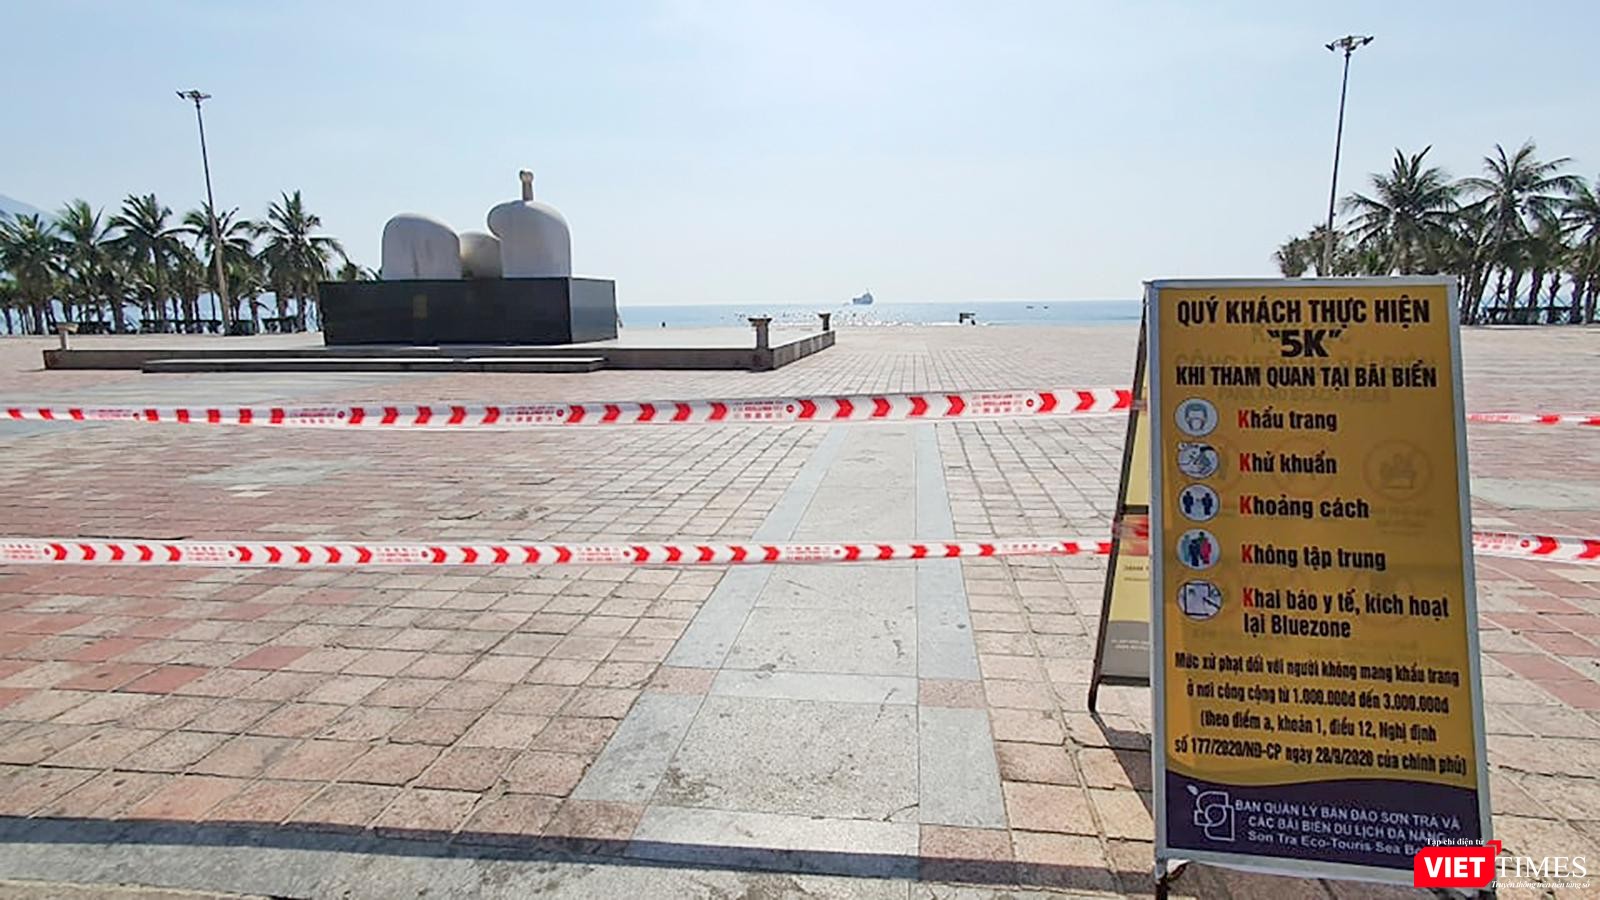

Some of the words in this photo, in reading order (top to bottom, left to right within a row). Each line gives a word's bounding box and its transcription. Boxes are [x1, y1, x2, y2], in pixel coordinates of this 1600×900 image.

[1177, 295, 1219, 326] QUÝ
[1226, 295, 1301, 323] KHÁCH
[1308, 297, 1367, 328] THỰC
[1374, 294, 1430, 328] HIỆN
[1176, 366, 1205, 386] KHI
[1210, 366, 1260, 386] THAM
[1266, 366, 1315, 388] QUAN
[1320, 367, 1349, 390] TẠI
[1355, 364, 1385, 387] BÃI
[1392, 359, 1437, 387] BIỂN
[1238, 405, 1283, 429] Khẩu
[1289, 410, 1337, 432] trang
[1240, 451, 1274, 472] Khử
[1280, 450, 1337, 474] khuẩn
[1240, 494, 1313, 518] Khoảng
[1320, 497, 1369, 518] cách
[1242, 544, 1298, 568] Không
[1303, 546, 1332, 571] tập
[1338, 548, 1386, 571] trung
[1243, 587, 1280, 608] Khai
[1286, 589, 1318, 611] báo
[1323, 595, 1332, 613] y
[1338, 587, 1360, 616] tế,
[1365, 592, 1403, 615] kích
[1409, 595, 1449, 621] hoạt
[1244, 613, 1265, 638] lại
[1271, 614, 1351, 638] Bluezone
[1219, 655, 1243, 675] phạt
[1322, 661, 1357, 680] không
[1360, 665, 1393, 682] mang
[1427, 668, 1460, 687] trang
[1217, 683, 1245, 702] công
[1248, 684, 1275, 705] cộng
[1359, 688, 1380, 708] đến
[1200, 710, 1230, 727] (theo
[1263, 720, 1274, 732] a,
[1277, 715, 1313, 733] khoản
[1315, 718, 1327, 736] 1,
[1359, 720, 1377, 739] 12,
[1410, 723, 1438, 744] định
[1174, 733, 1189, 753] số
[1285, 746, 1313, 764] ngày
[1377, 749, 1399, 769] của
[1402, 753, 1436, 772] chính
[1235, 800, 1261, 812] BAN
